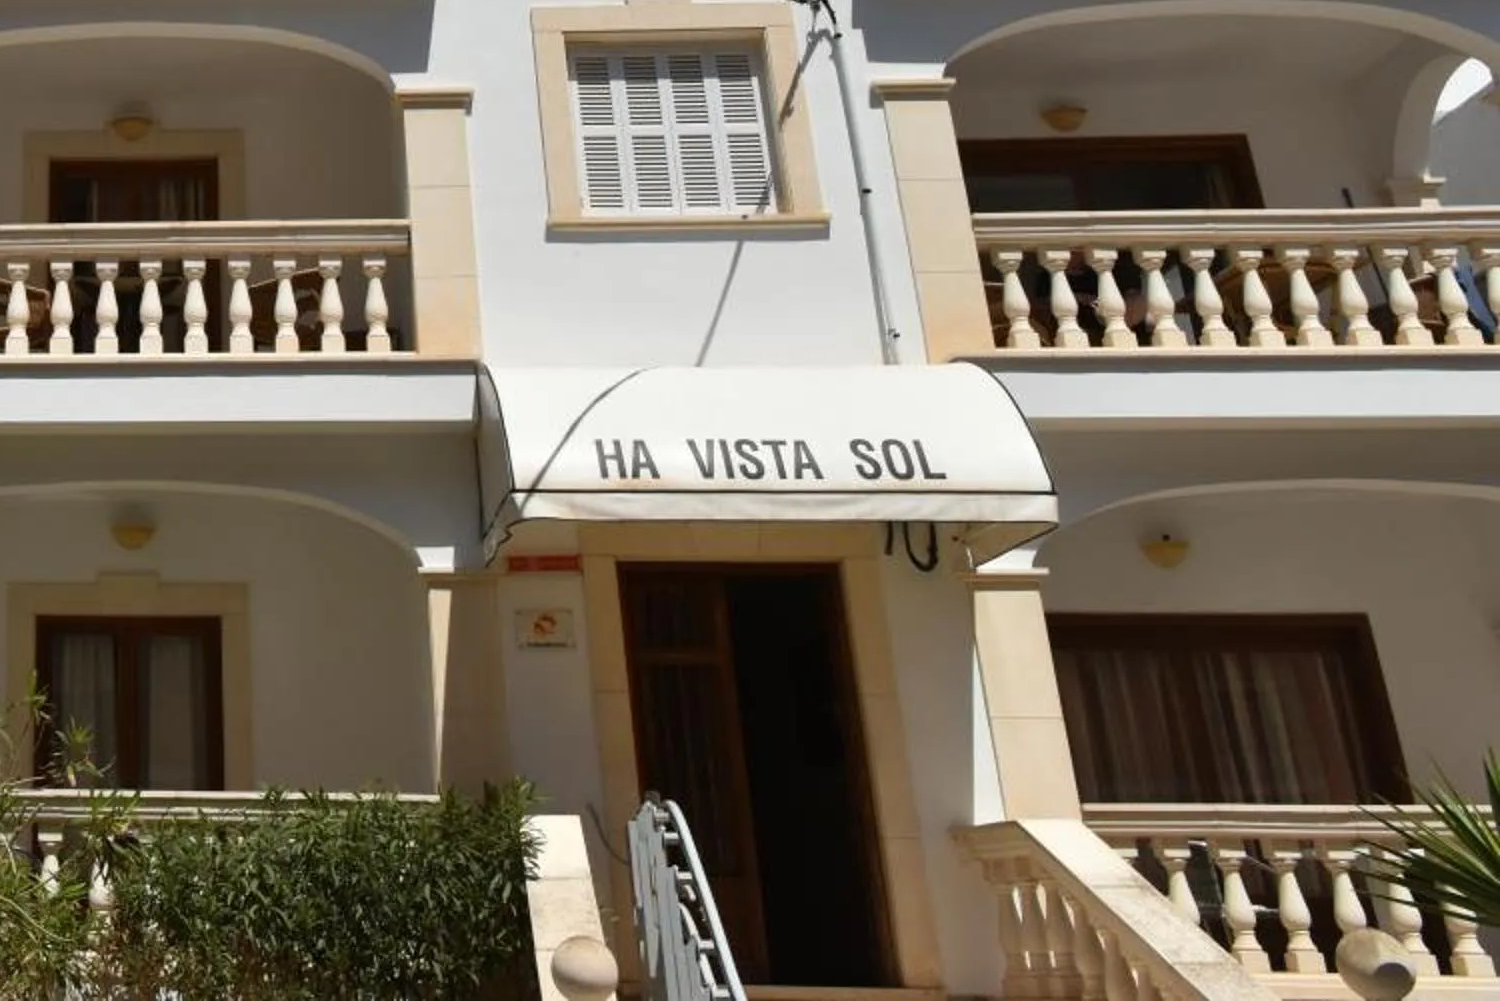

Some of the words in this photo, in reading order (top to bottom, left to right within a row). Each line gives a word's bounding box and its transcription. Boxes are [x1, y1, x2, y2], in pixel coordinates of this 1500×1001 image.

[595, 439, 661, 480] HA
[687, 439, 824, 480] VISTA
[849, 438, 947, 481] SOL
